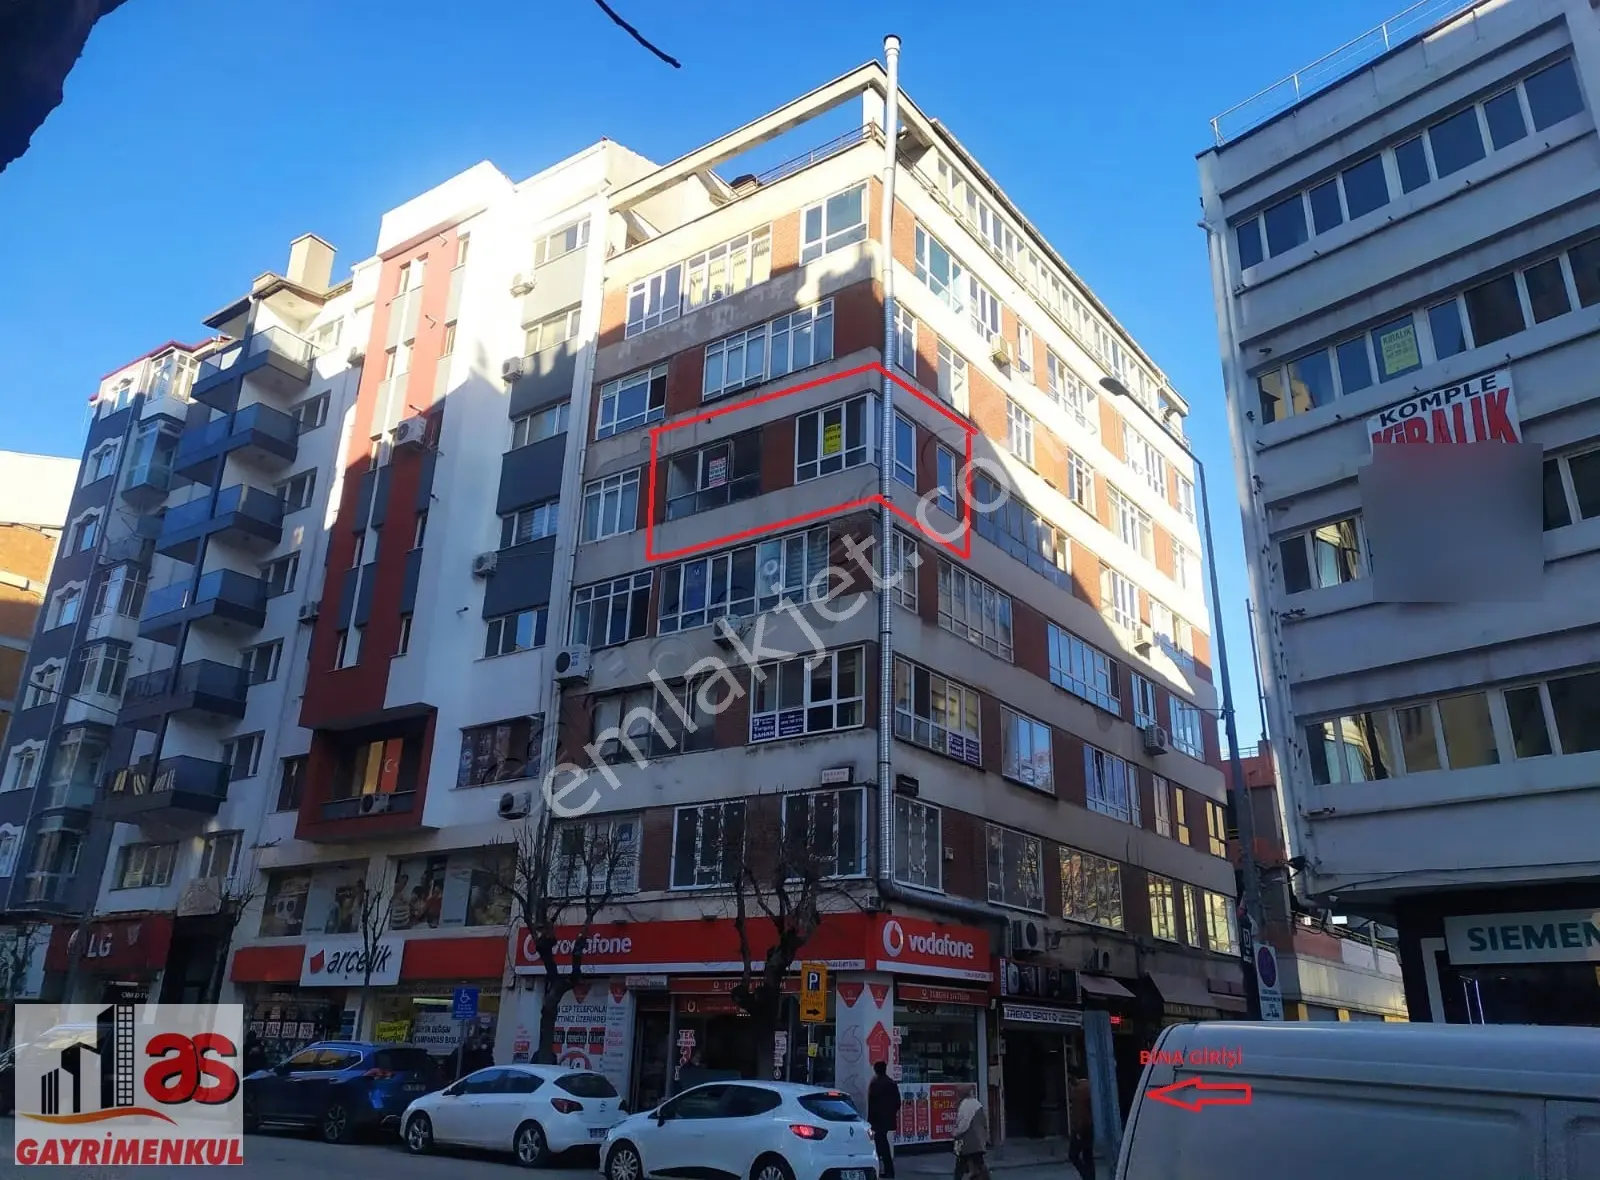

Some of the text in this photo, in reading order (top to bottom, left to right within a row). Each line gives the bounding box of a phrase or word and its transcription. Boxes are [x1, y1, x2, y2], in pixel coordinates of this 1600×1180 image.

[1379, 374, 1497, 427] KOMPLE
[1371, 387, 1519, 444] RALIK
[87, 931, 113, 958] LG
[907, 931, 975, 960] vodafone
[809, 972, 818, 990] P
